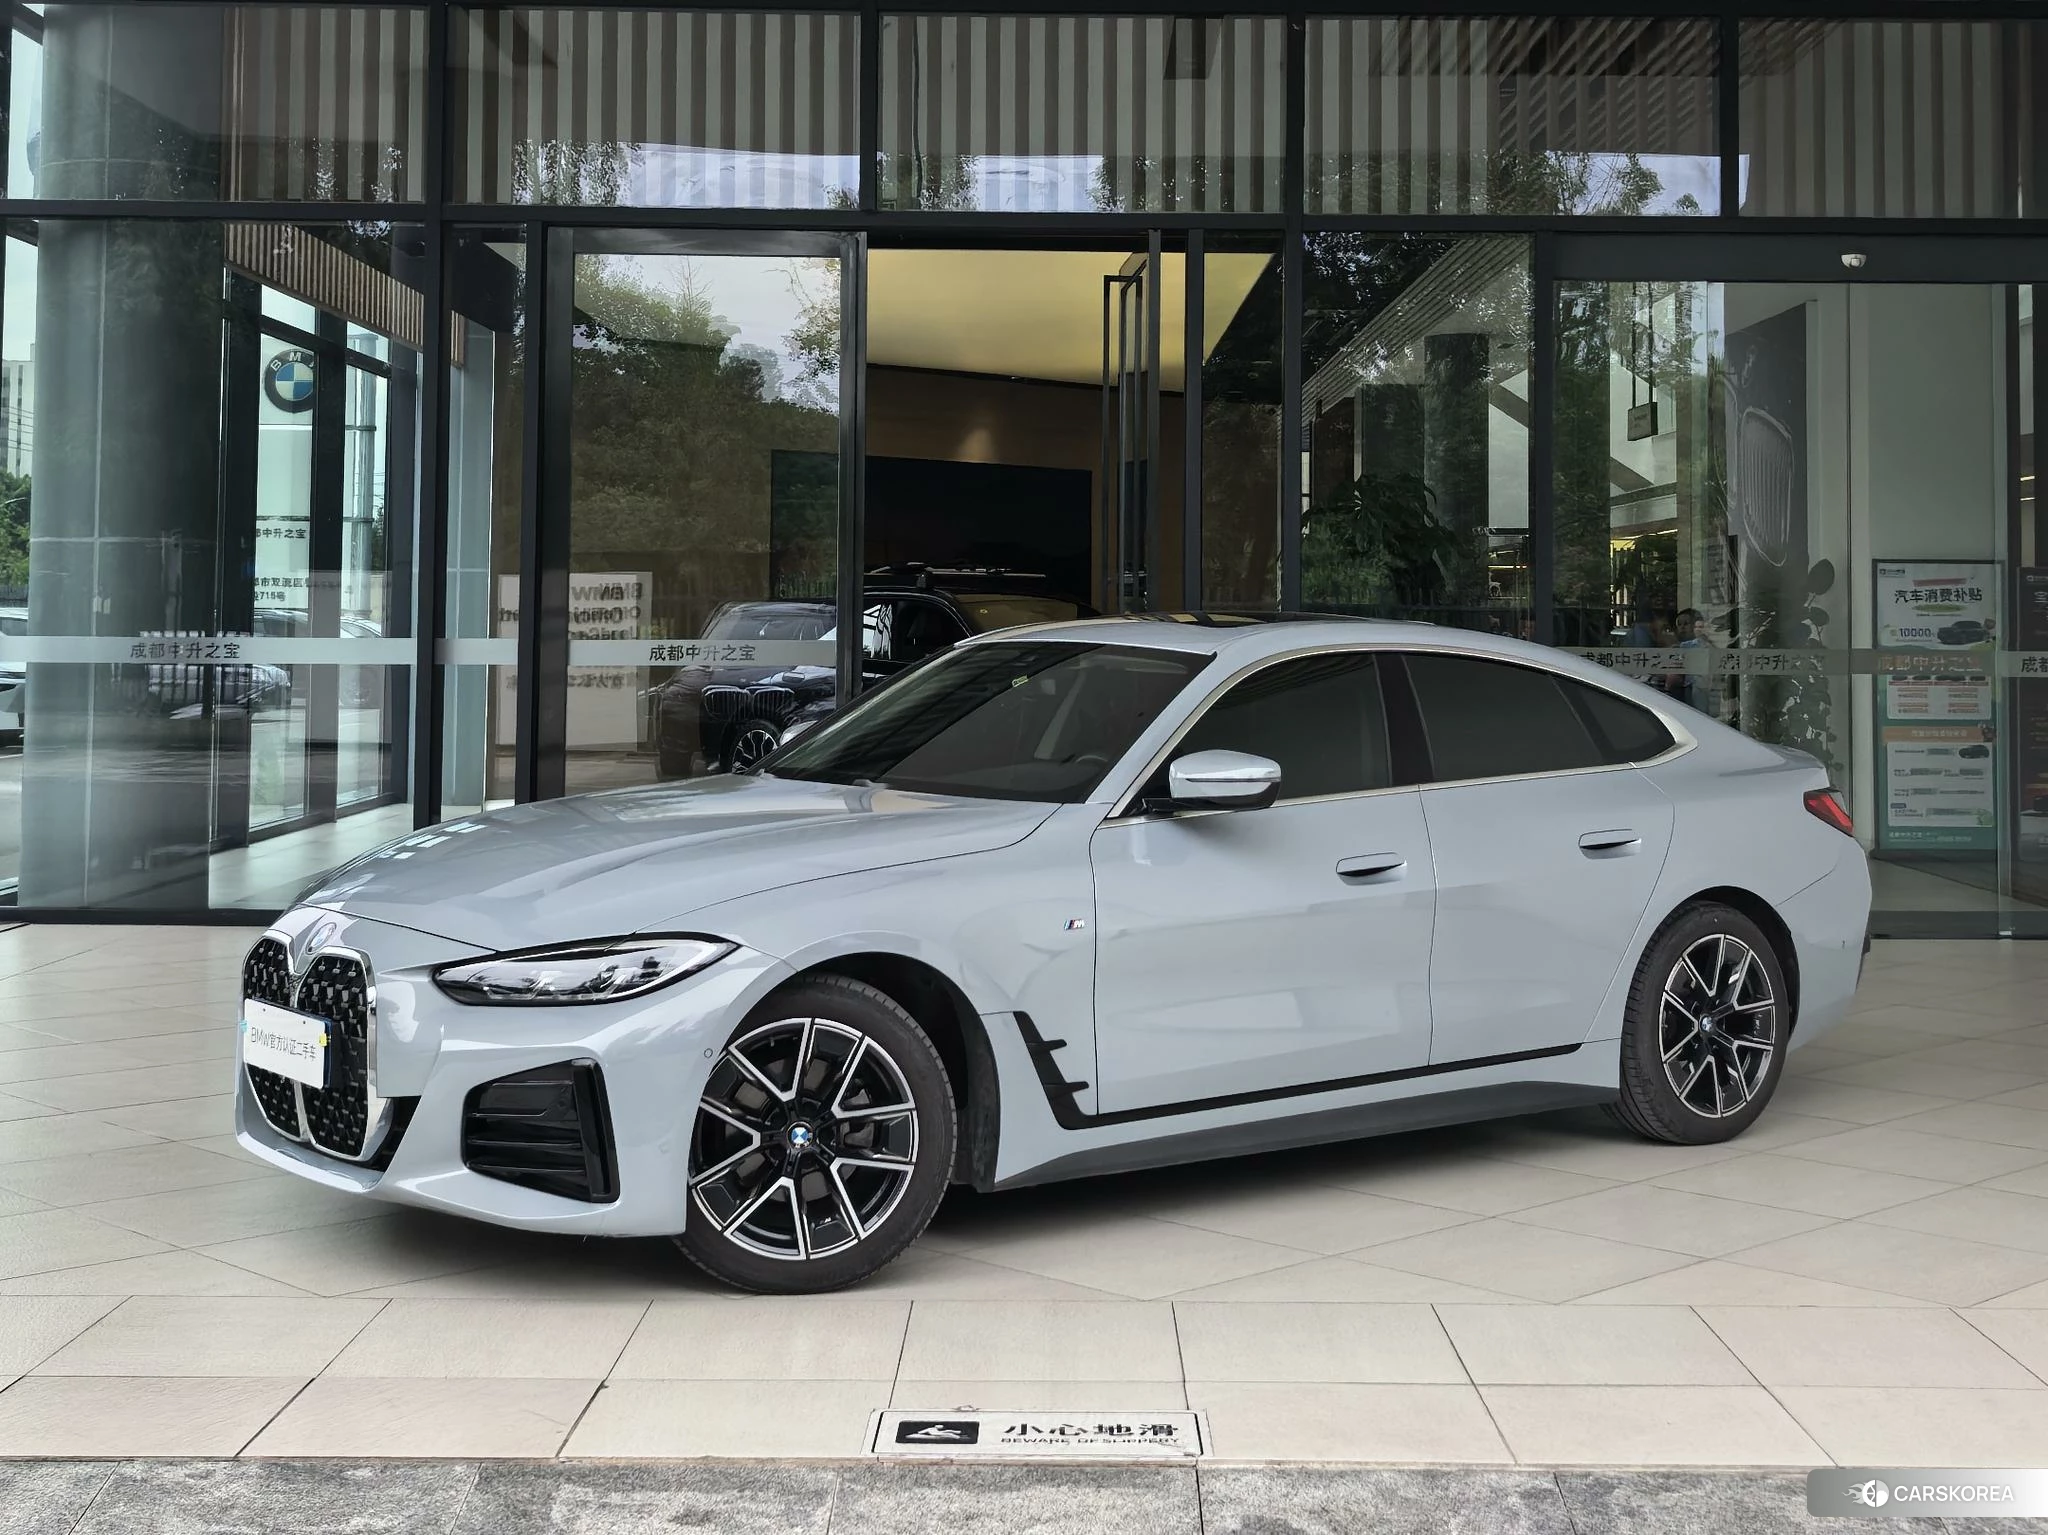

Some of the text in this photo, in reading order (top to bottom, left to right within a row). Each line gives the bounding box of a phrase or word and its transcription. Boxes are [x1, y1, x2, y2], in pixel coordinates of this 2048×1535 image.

[271, 351, 314, 371] BM
[1895, 588, 1982, 603] 汽车消费补贴
[130, 642, 240, 659] 成都中升之宝
[649, 644, 756, 661] 成都中升之宝
[1003, 1423, 1179, 1436] 小心地滑
